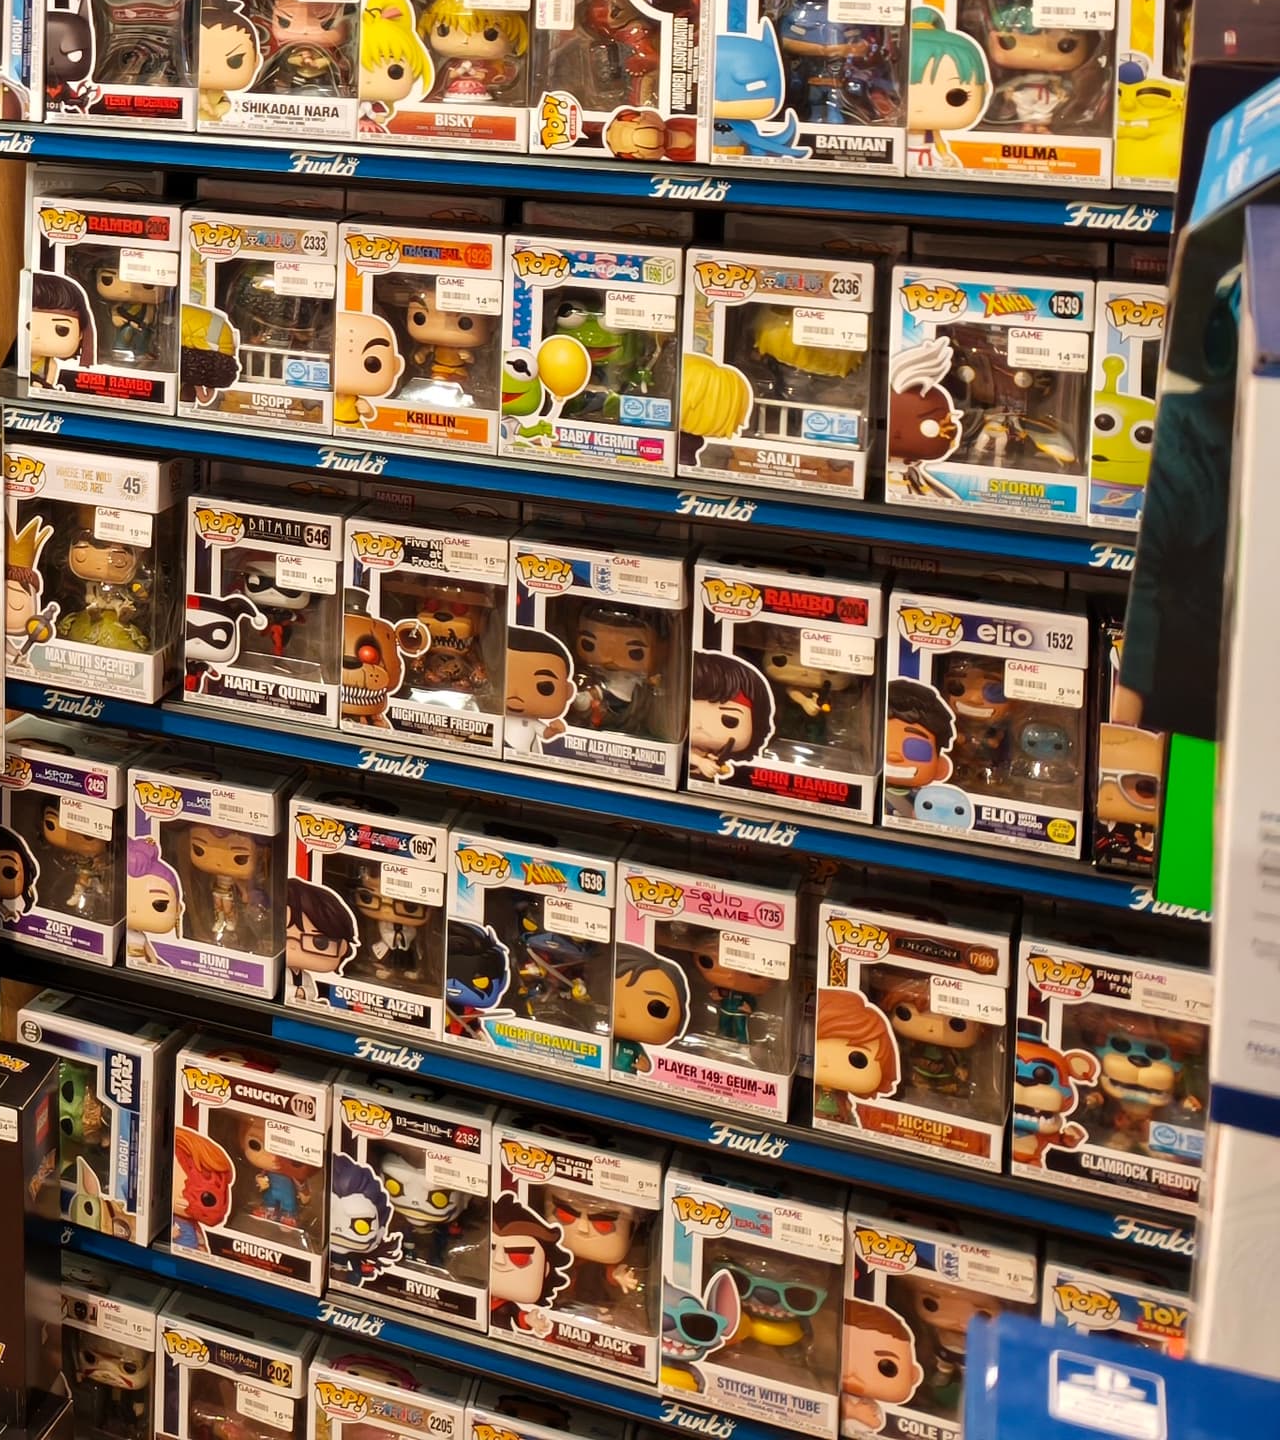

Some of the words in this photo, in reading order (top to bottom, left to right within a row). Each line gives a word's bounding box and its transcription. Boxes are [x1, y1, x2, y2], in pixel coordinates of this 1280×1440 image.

[241, 100, 299, 118] SHIKADAI
[303, 103, 340, 119] NARA
[433, 113, 475, 129] BISKY
[815, 133, 887, 152] BATMAN
[1000, 143, 1058, 161] BULMA
[1050, 295, 1081, 315] 1539
[252, 393, 294, 410] USOPP
[406, 410, 457, 429] KRILLIN
[558, 427, 590, 447] BABY
[594, 432, 639, 450] KERMIT
[756, 449, 801, 470] SANJI
[988, 477, 1046, 499] STORM
[675, 491, 759, 522] Funko
[223, 674, 273, 695] HARLEY
[279, 681, 321, 705] QUINN
[391, 706, 448, 731] NIGHTMARE
[450, 717, 489, 736] FREDDY
[563, 736, 585, 753] TRENT
[587, 742, 667, 767] ALEXANDER-ARNOLD
[45, 920, 74, 938] ZOEY
[199, 951, 231, 969] RUMI
[334, 985, 384, 1010] SOSUKE
[386, 995, 425, 1018] AIZEN
[494, 1022, 599, 1059] NIGHTCRAWLER
[656, 1057, 696, 1079] PLAYER
[698, 1064, 723, 1084] 149:
[725, 1071, 777, 1098] GEUM-JA
[896, 1112, 953, 1138] HICCUP
[1080, 1152, 1147, 1183] GLAMROCK
[1150, 1166, 1199, 1192] FREDDY
[231, 1238, 283, 1265] CHUCKY
[405, 1277, 441, 1301] RYUK
[557, 1320, 590, 1342] MAD
[593, 1330, 633, 1356] JACK
[716, 1375, 755, 1399] STITCH
[757, 1387, 787, 1406] WITH
[790, 1396, 822, 1416] TUBE
